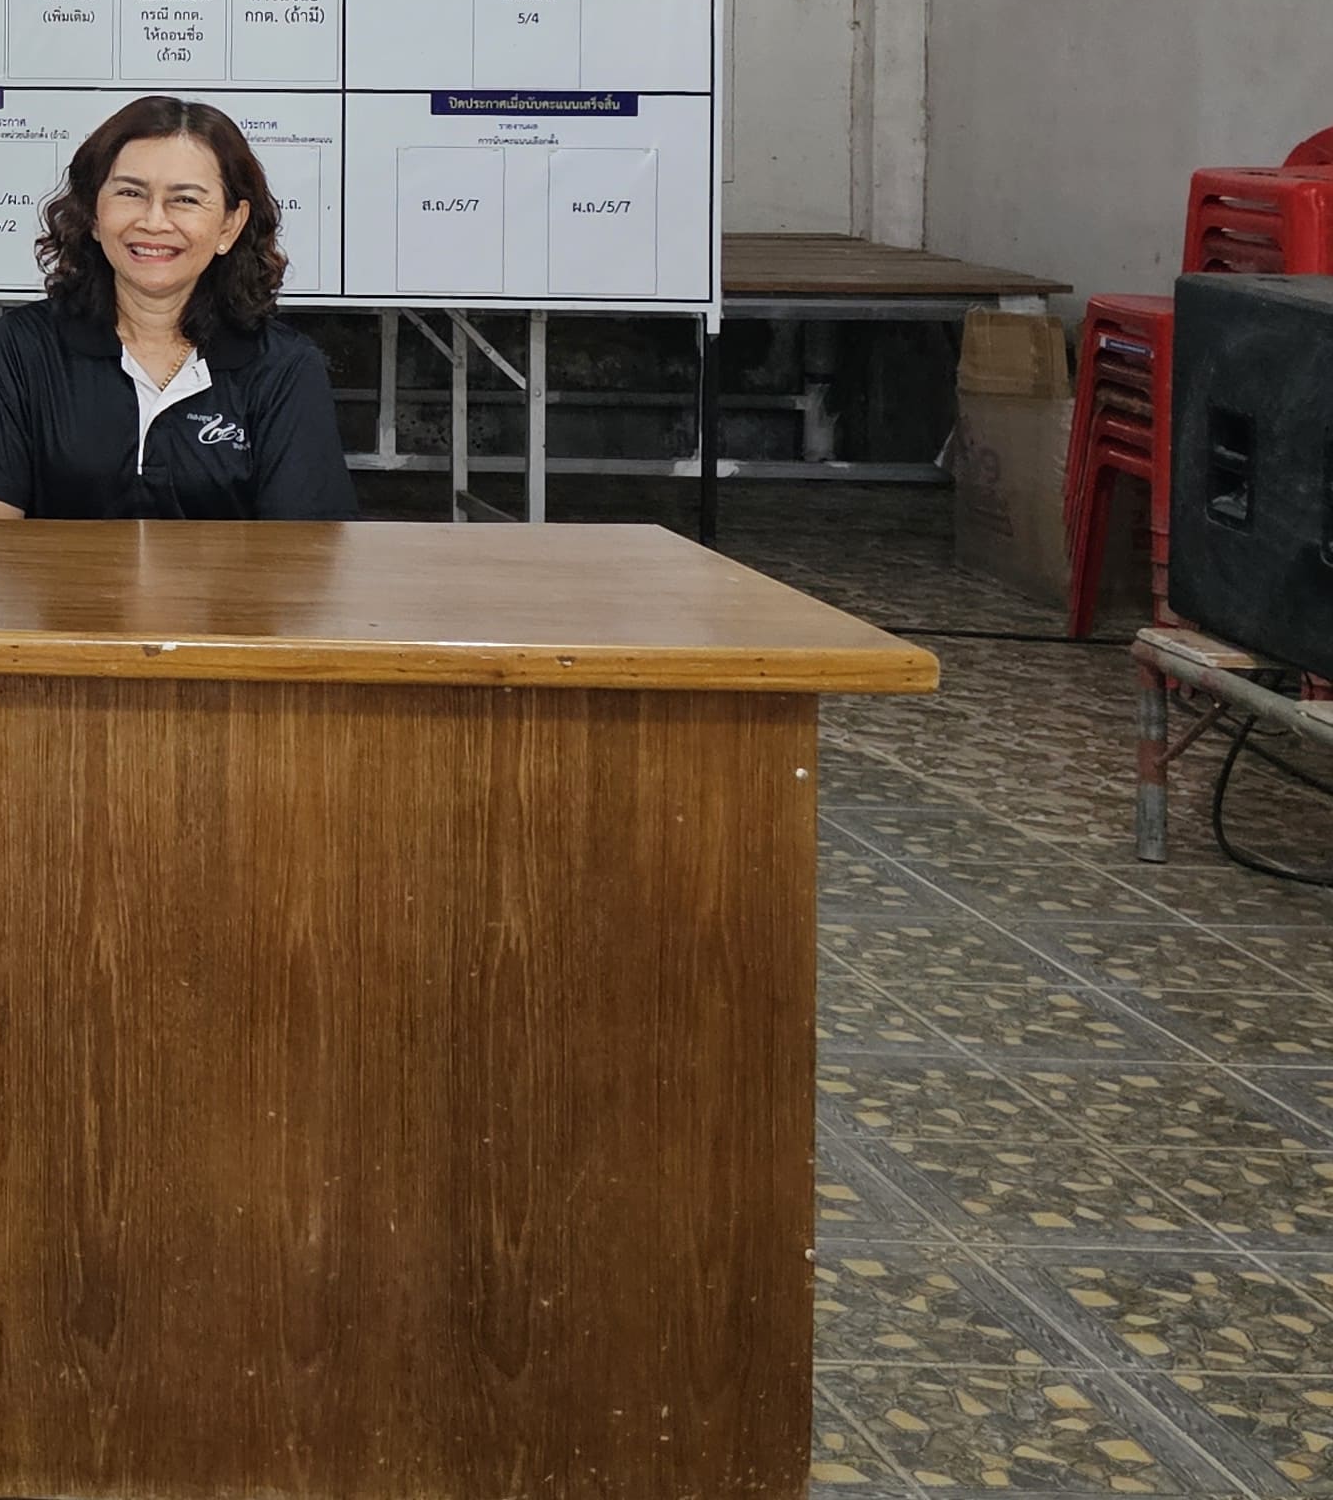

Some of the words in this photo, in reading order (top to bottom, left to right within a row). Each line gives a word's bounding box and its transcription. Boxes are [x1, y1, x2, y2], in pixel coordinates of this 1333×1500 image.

[42, 5, 95, 24] (เพิ่มเติม)
[140, 6, 169, 21] กรณี
[173, 10, 204, 21] กกต.
[245, 10, 279, 23] กกต.
[284, 4, 325, 25] (ถ้ามี)
[517, 12, 540, 25] 5/4
[143, 24, 204, 42] ให้ถอนชื่อ
[156, 46, 192, 63] (ถ้ามี)
[448, 93, 621, 111] ปิดประกาศเมื่อนับคะแนนเสร็จสิ้น
[240, 119, 278, 130] ประกาศ
[421, 198, 480, 212] ส.ถ./5/7
[572, 200, 632, 214] ผ.ถ./5/7
